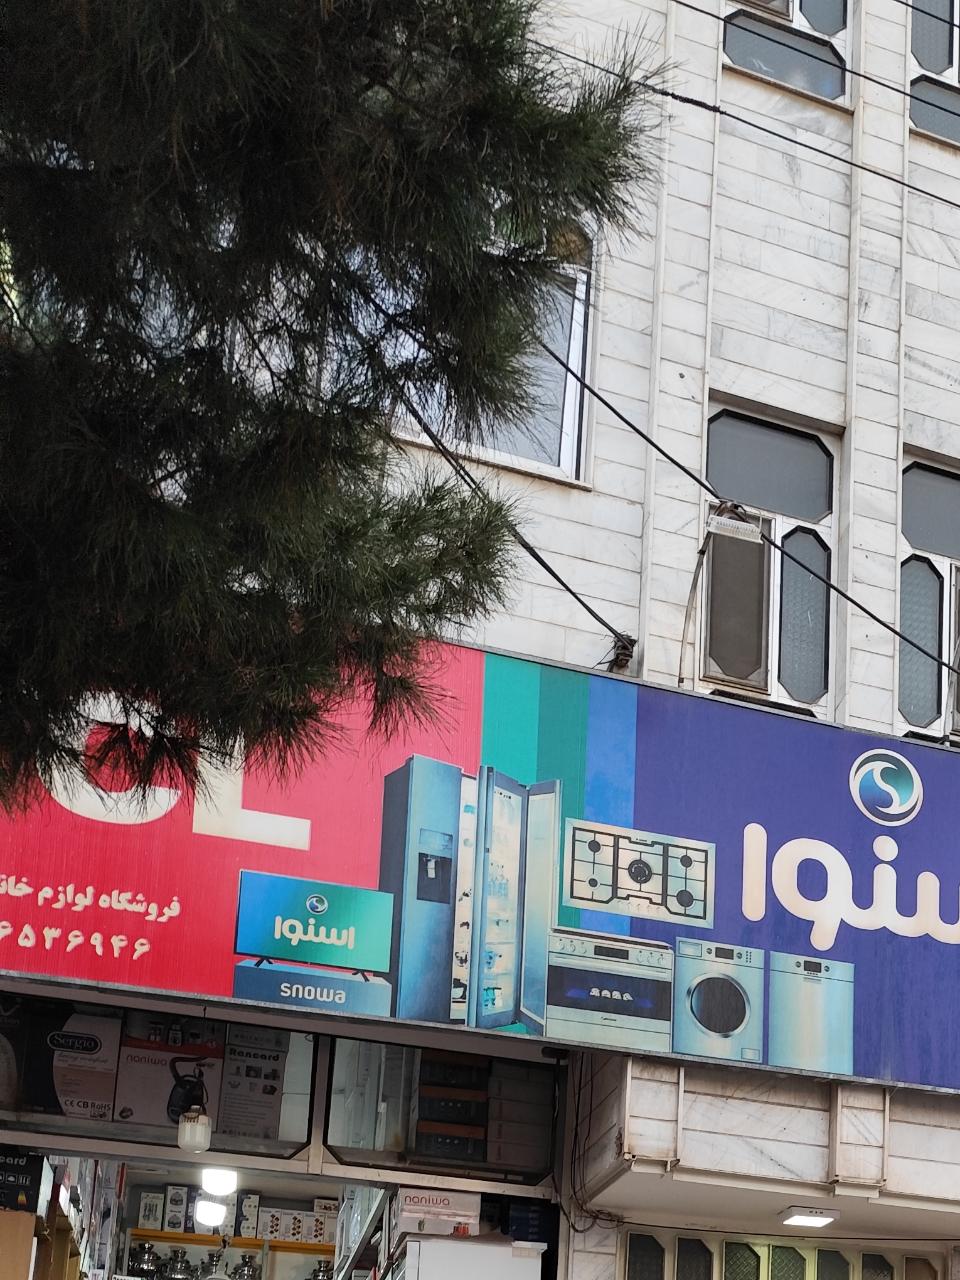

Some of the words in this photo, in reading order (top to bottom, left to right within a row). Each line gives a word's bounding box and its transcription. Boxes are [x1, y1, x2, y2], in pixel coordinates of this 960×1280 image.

[38, 883, 95, 912] لوازم
[99, 889, 181, 923] فروشگاه
[273, 915, 355, 950] اسنوا
[280, 983, 347, 1005] snowa
[404, 1194, 451, 1207] naniwa
